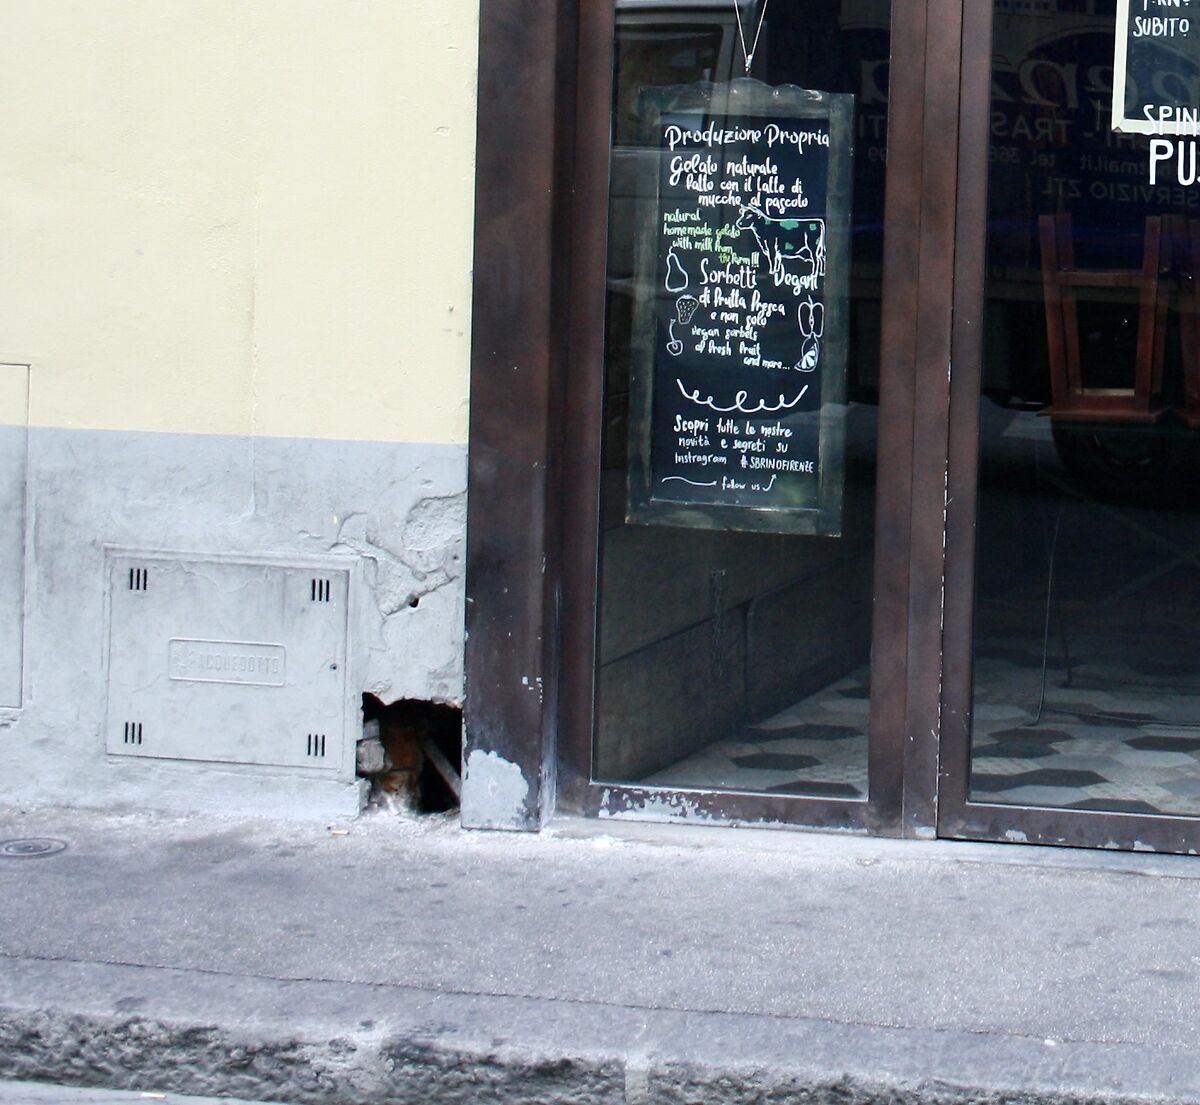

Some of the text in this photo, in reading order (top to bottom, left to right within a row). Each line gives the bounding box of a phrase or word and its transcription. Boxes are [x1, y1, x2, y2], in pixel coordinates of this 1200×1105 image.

[1132, 15, 1190, 38] SUBITO
[665, 121, 762, 151] Produzione
[763, 124, 830, 154] Propria
[726, 155, 778, 177] naturale
[687, 173, 803, 195] fatto con il latte di
[699, 190, 808, 215] mucche al pascolo
[664, 209, 701, 221] natural
[716, 224, 741, 239] gelato
[672, 239, 733, 253] with milk from
[700, 258, 757, 289] Sorbetti
[699, 287, 786, 318] di frutta fresca
[711, 312, 767, 330] e non solo
[692, 325, 758, 341] vegan sorbets
[695, 340, 760, 356] of fresh fruit
[743, 355, 760, 367] and
[674, 414, 793, 438] Scopri tutte le nostre
[678, 435, 788, 453] novità e segreti su
[722, 476, 760, 491] follow us
